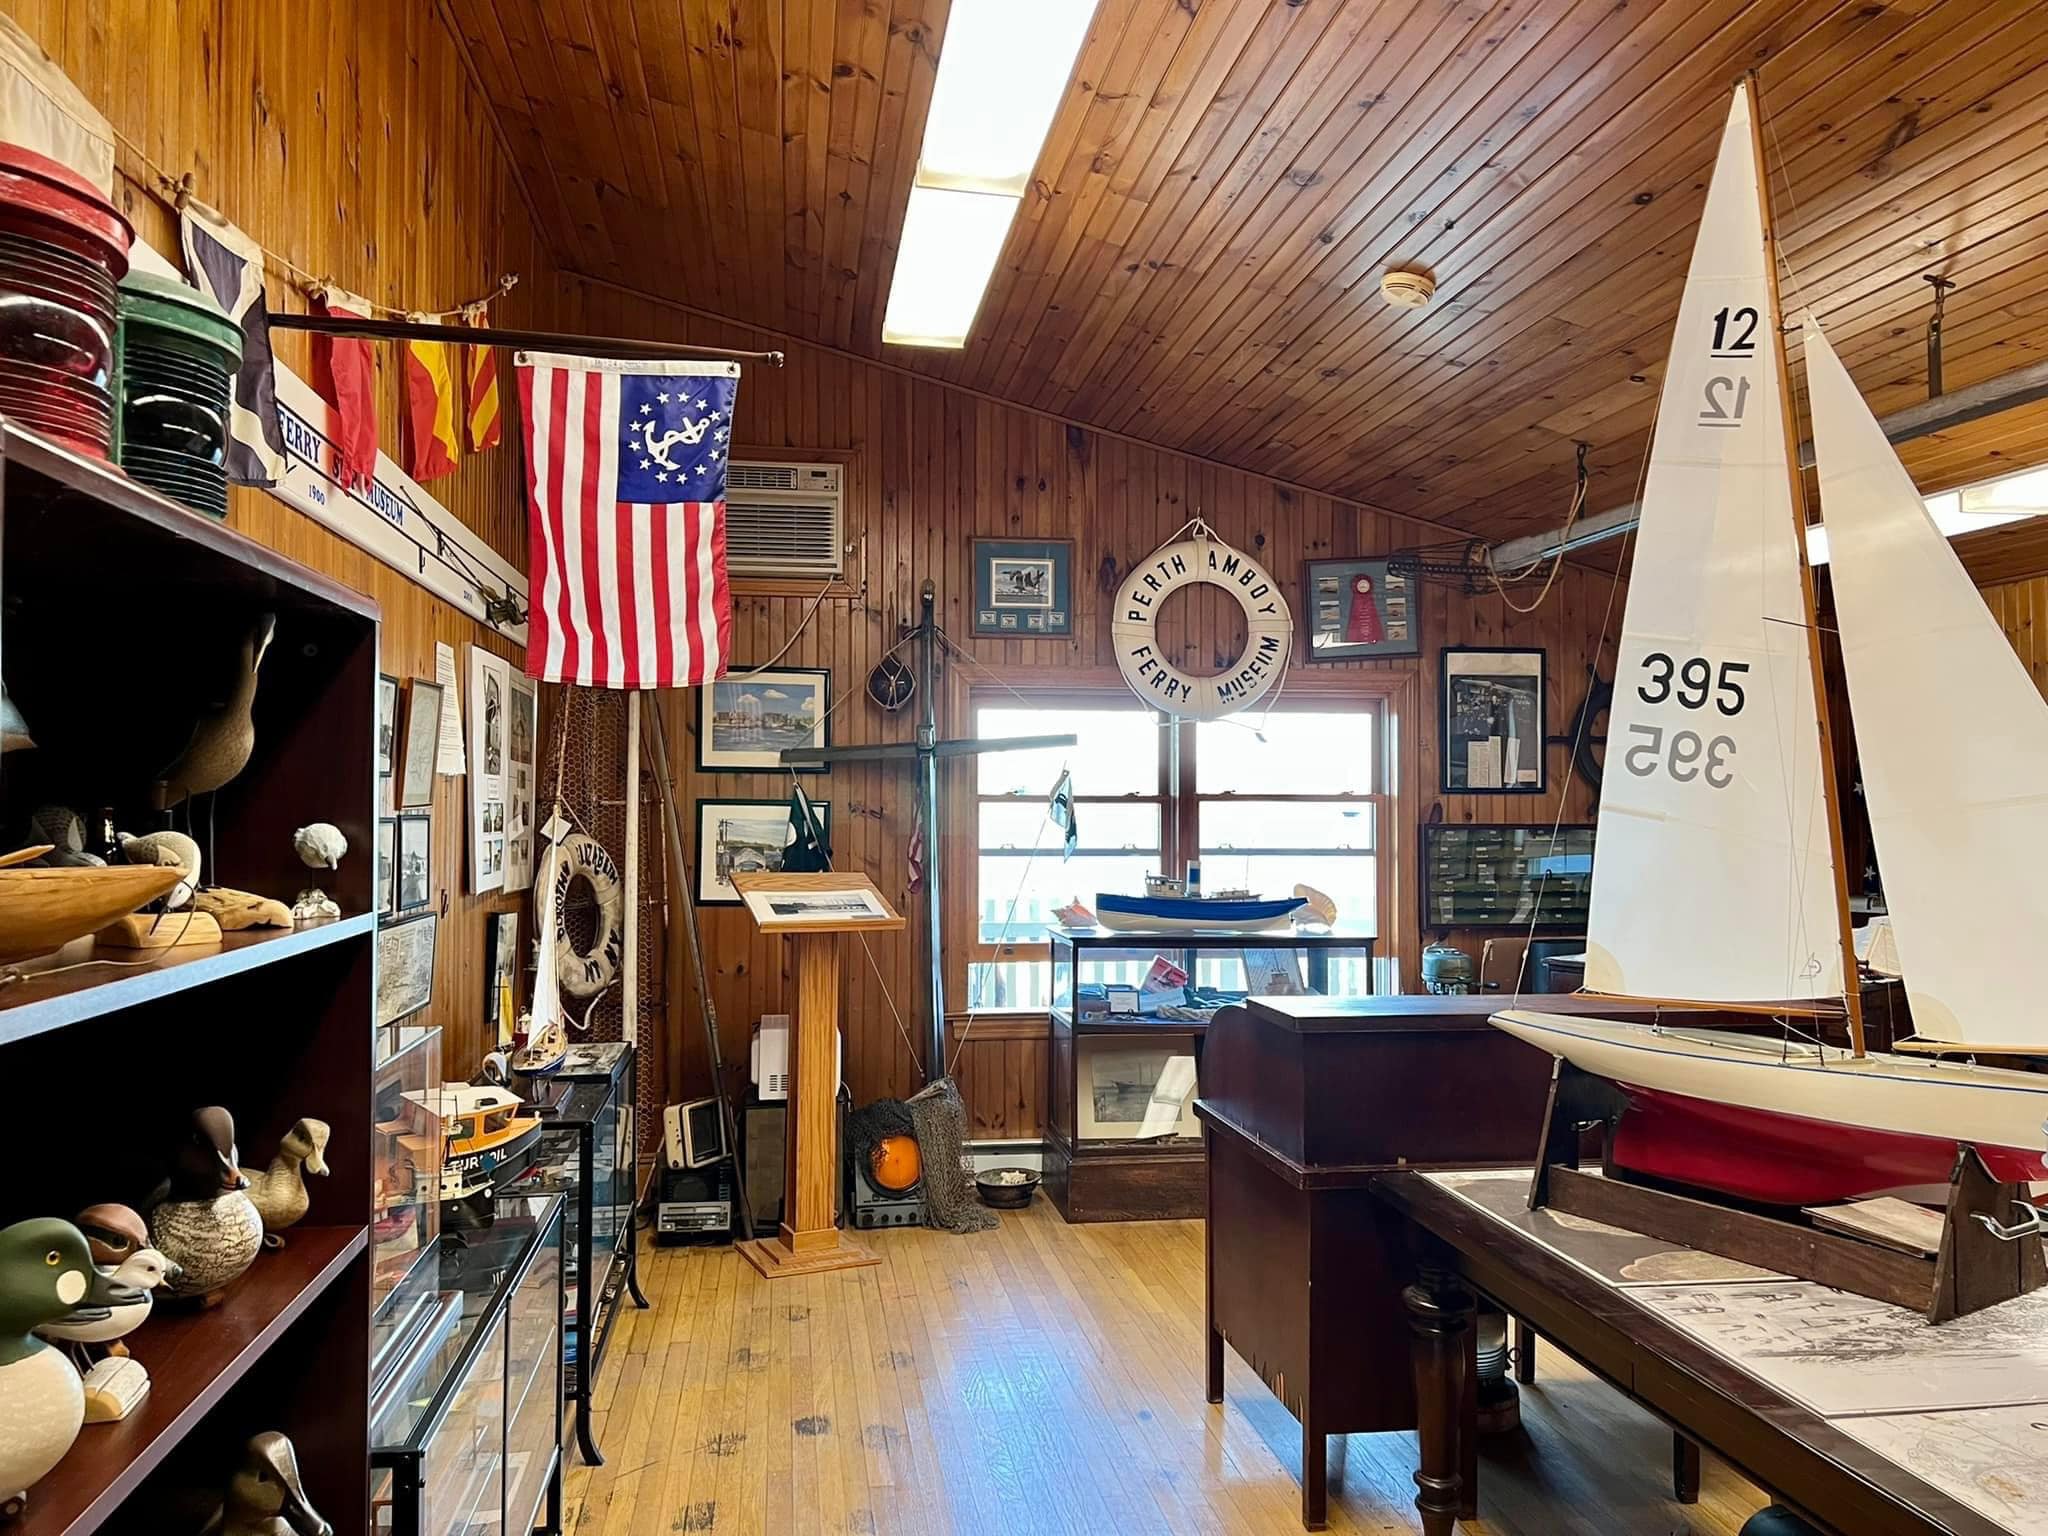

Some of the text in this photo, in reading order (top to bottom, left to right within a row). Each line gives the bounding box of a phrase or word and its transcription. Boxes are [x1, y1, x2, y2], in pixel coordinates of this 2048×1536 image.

[1711, 306, 1759, 350] 12
[1128, 550, 1277, 622] PERTH AMBOY
[1131, 636, 1280, 704] FERRY MUSEUM
[1638, 652, 1750, 716] 395
[447, 1148, 508, 1171] TURIL
